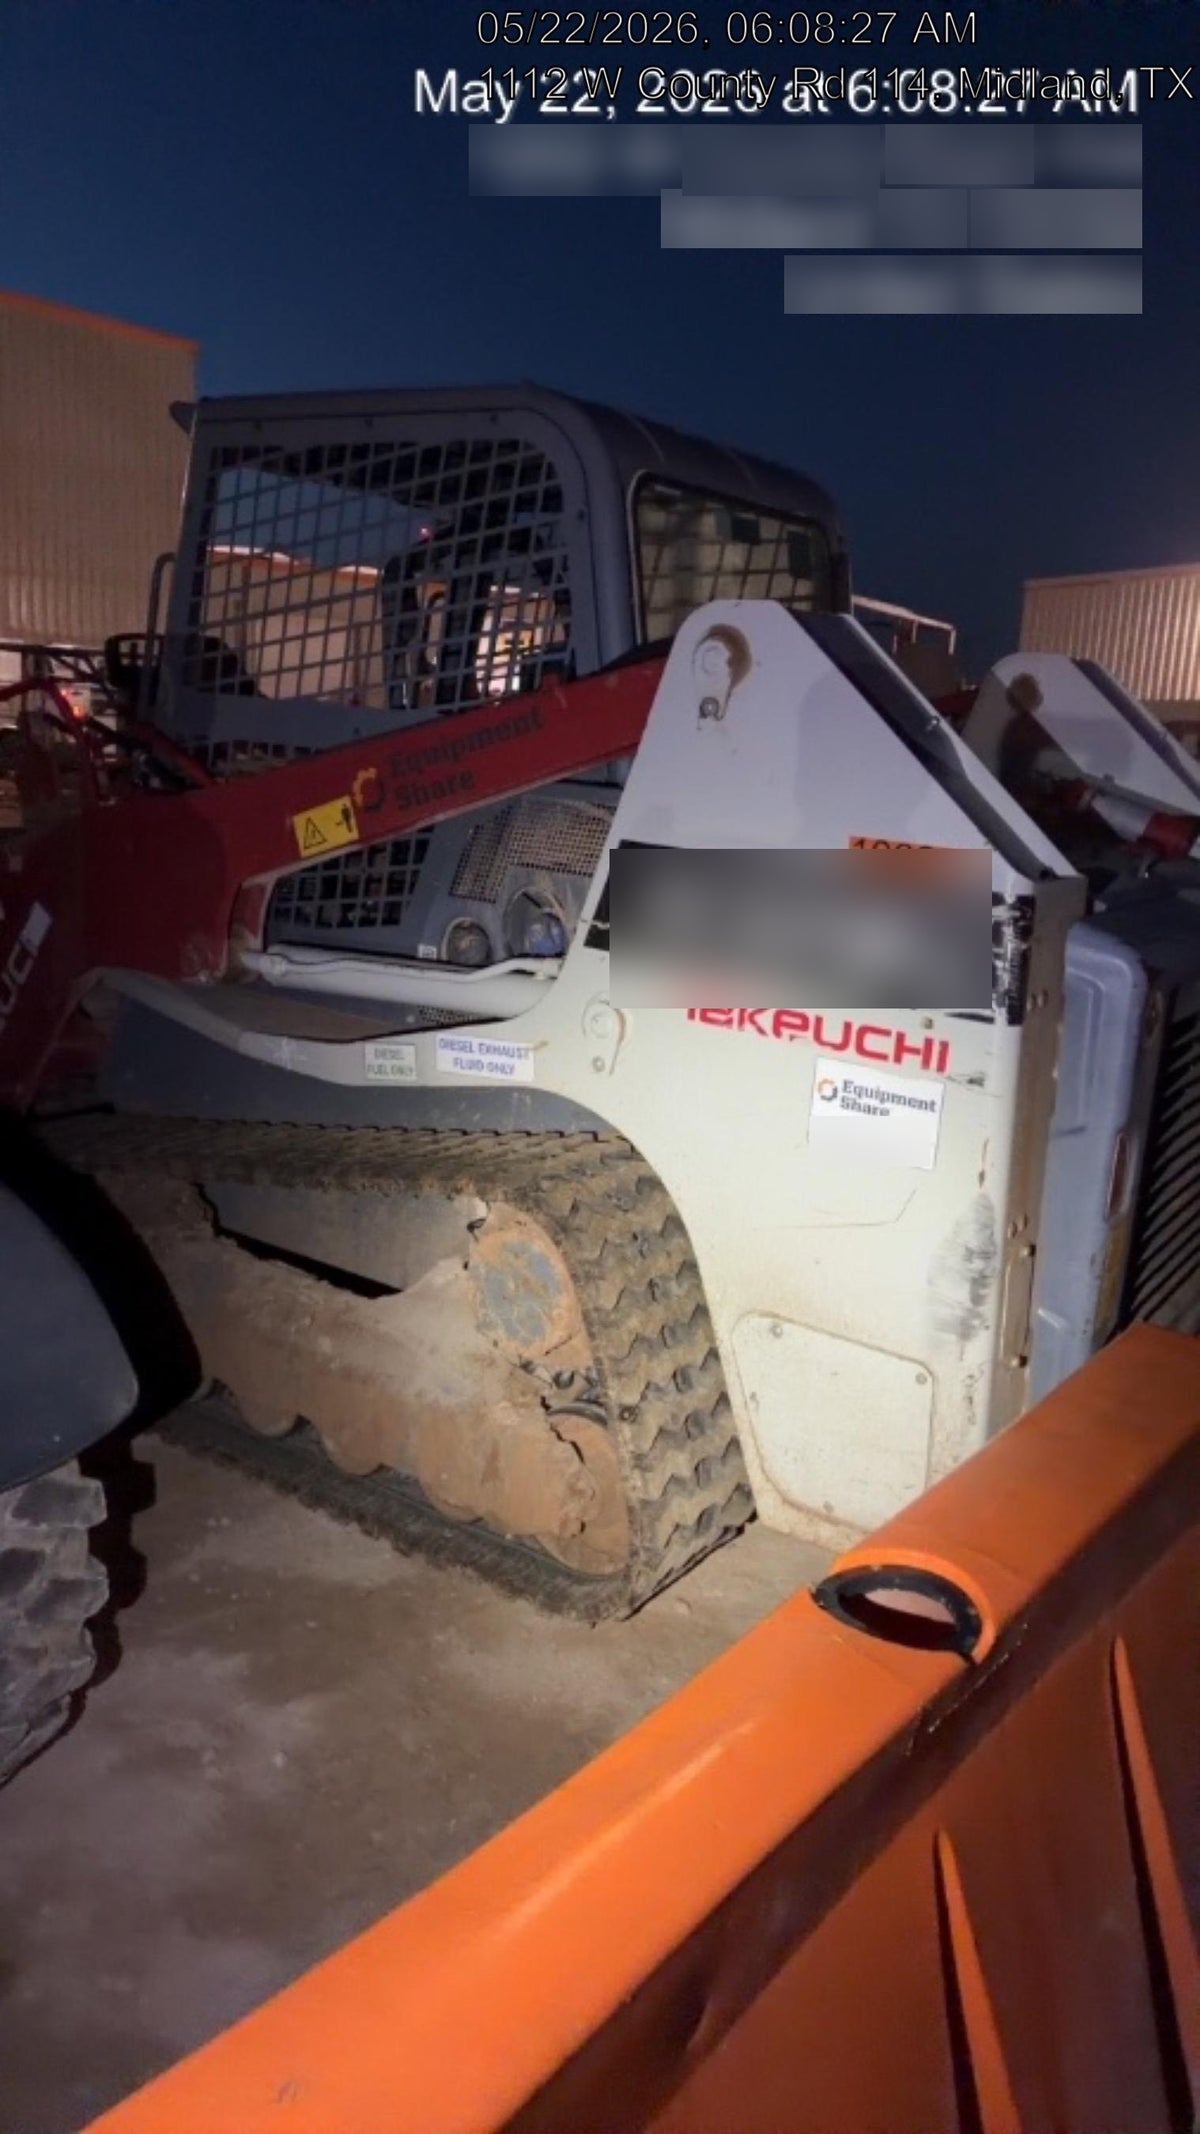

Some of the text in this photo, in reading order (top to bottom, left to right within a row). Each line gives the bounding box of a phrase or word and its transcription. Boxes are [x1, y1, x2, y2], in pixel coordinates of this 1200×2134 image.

[388, 706, 545, 778] Equipment
[397, 769, 476, 812] Share
[439, 1038, 530, 1061] DIESEL EXHAUST
[453, 1057, 516, 1076] FLUID ONLY
[840, 1096, 890, 1117] Share
[841, 1079, 937, 1112] Equipment
